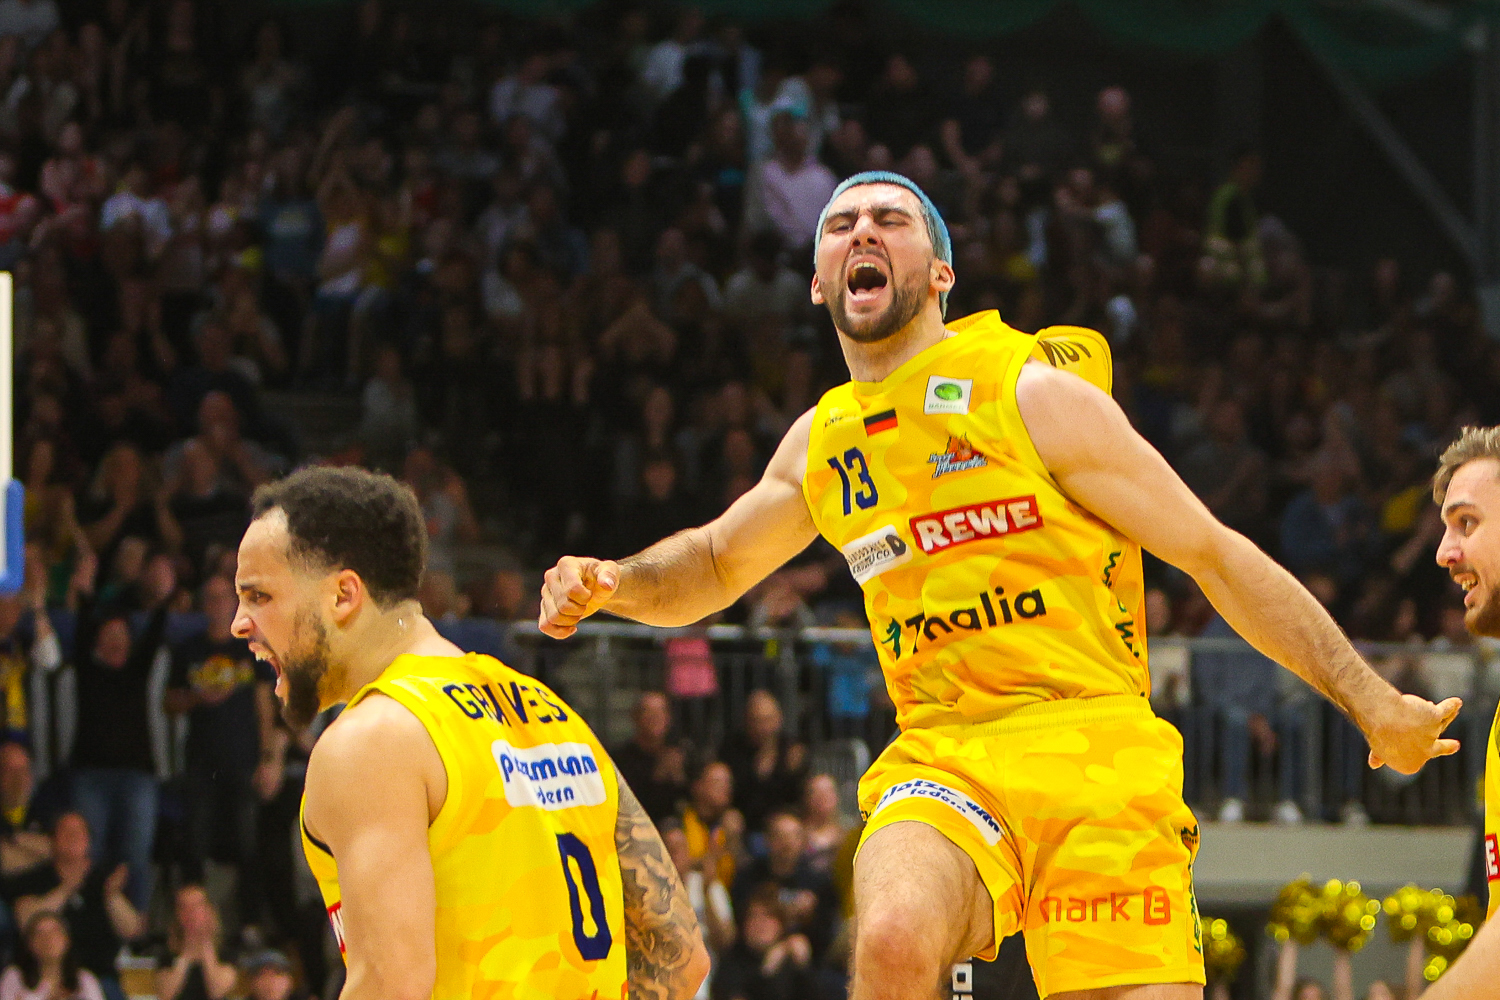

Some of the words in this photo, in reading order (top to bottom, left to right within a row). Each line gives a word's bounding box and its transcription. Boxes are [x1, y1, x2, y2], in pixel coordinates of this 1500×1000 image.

[827, 447, 879, 516] 13
[916, 501, 1038, 552] REWE
[905, 586, 1046, 654] Thalia
[556, 832, 613, 962] 0
